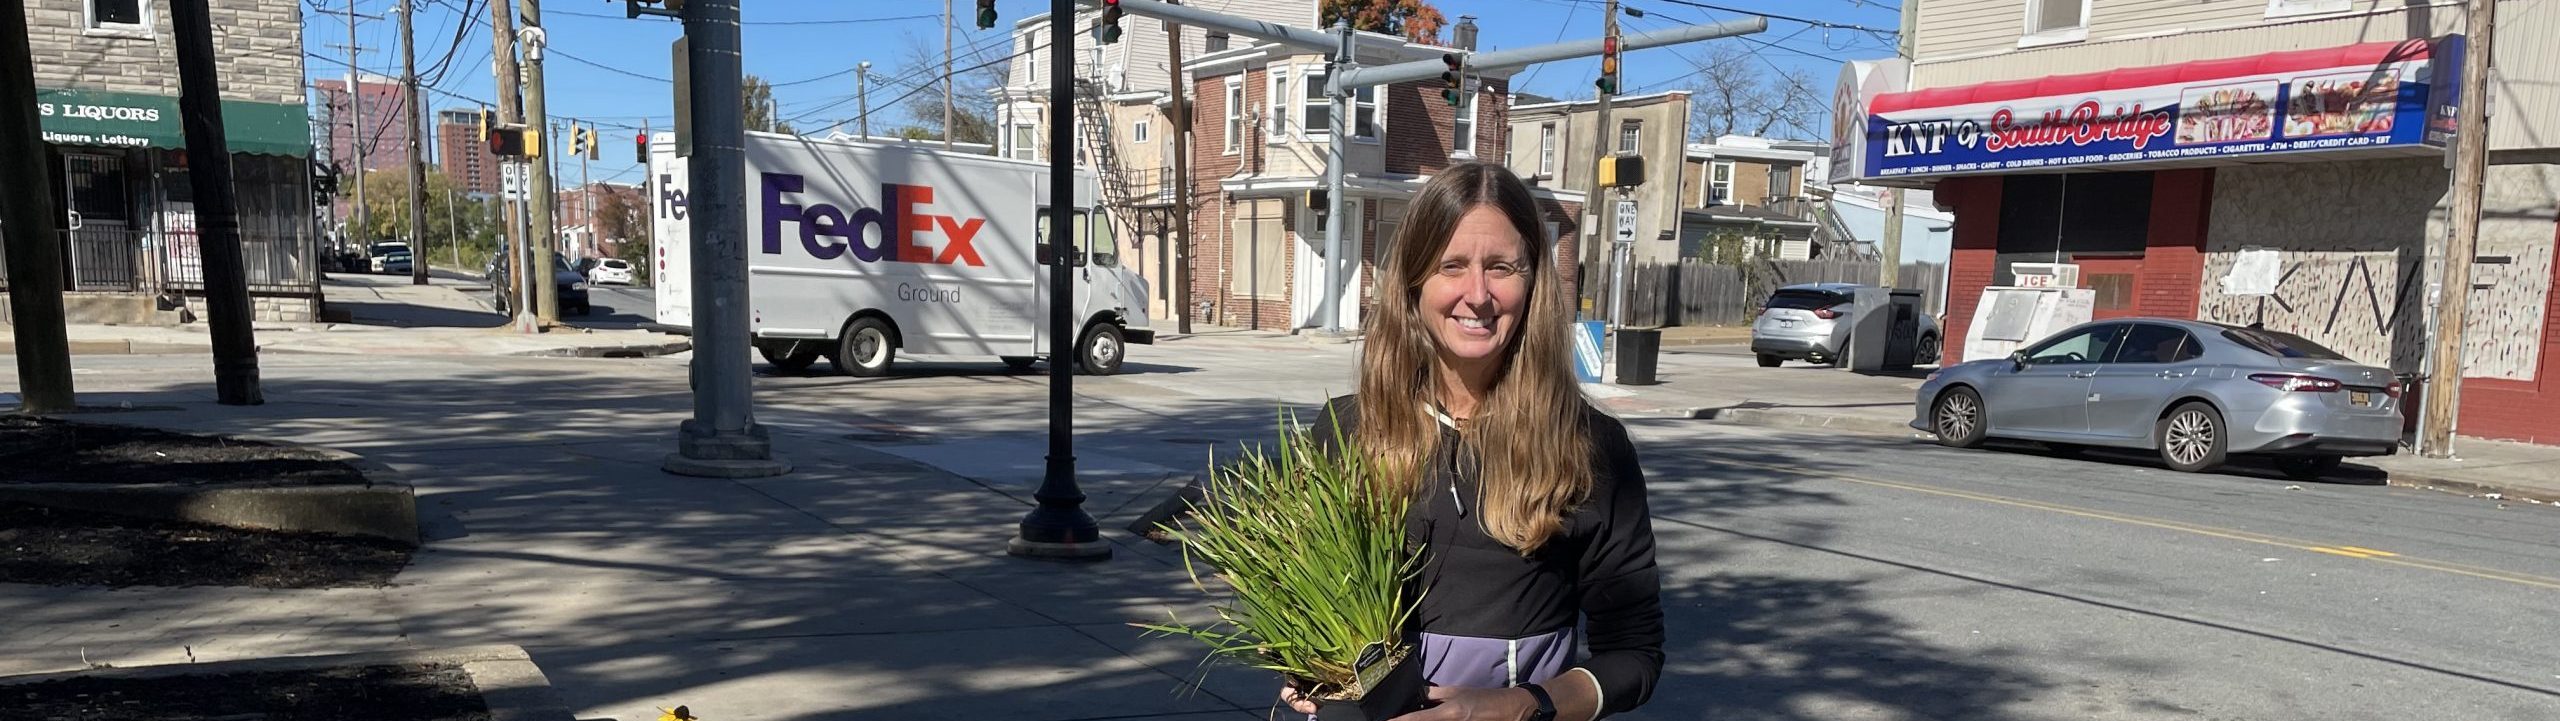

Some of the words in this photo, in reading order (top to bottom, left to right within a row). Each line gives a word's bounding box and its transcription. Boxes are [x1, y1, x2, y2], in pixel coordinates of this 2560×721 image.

[62, 104, 160, 121] LIQUORS
[42, 131, 91, 143] Liquors
[102, 134, 149, 147] Lottery
[1884, 119, 1952, 157] KNF
[1910, 165, 1929, 174] LUNCH
[1931, 164, 1952, 172] DINNER
[1980, 161, 2001, 169] CANDY
[2006, 160, 2022, 168] COLD
[2022, 158, 2044, 167] DRINKS
[2048, 157, 2061, 166] HOT
[2068, 156, 2085, 164] COLD
[2085, 154, 2104, 163] FOOD
[2108, 152, 2143, 161] GROCERIES
[2148, 149, 2180, 158] TOBACCO
[2181, 146, 2217, 157] PRODUCTS
[2222, 143, 2265, 154] CIGARETTES
[2270, 141, 2288, 150] ATM
[2347, 136, 2370, 146] CARD
[2376, 135, 2392, 144] EBT
[506, 166, 527, 175] OE
[506, 177, 527, 185] WY
[1620, 204, 1636, 214] ONE
[760, 171, 986, 267] FedEx
[2023, 274, 2048, 287] ICE
[897, 282, 961, 304] Ground
